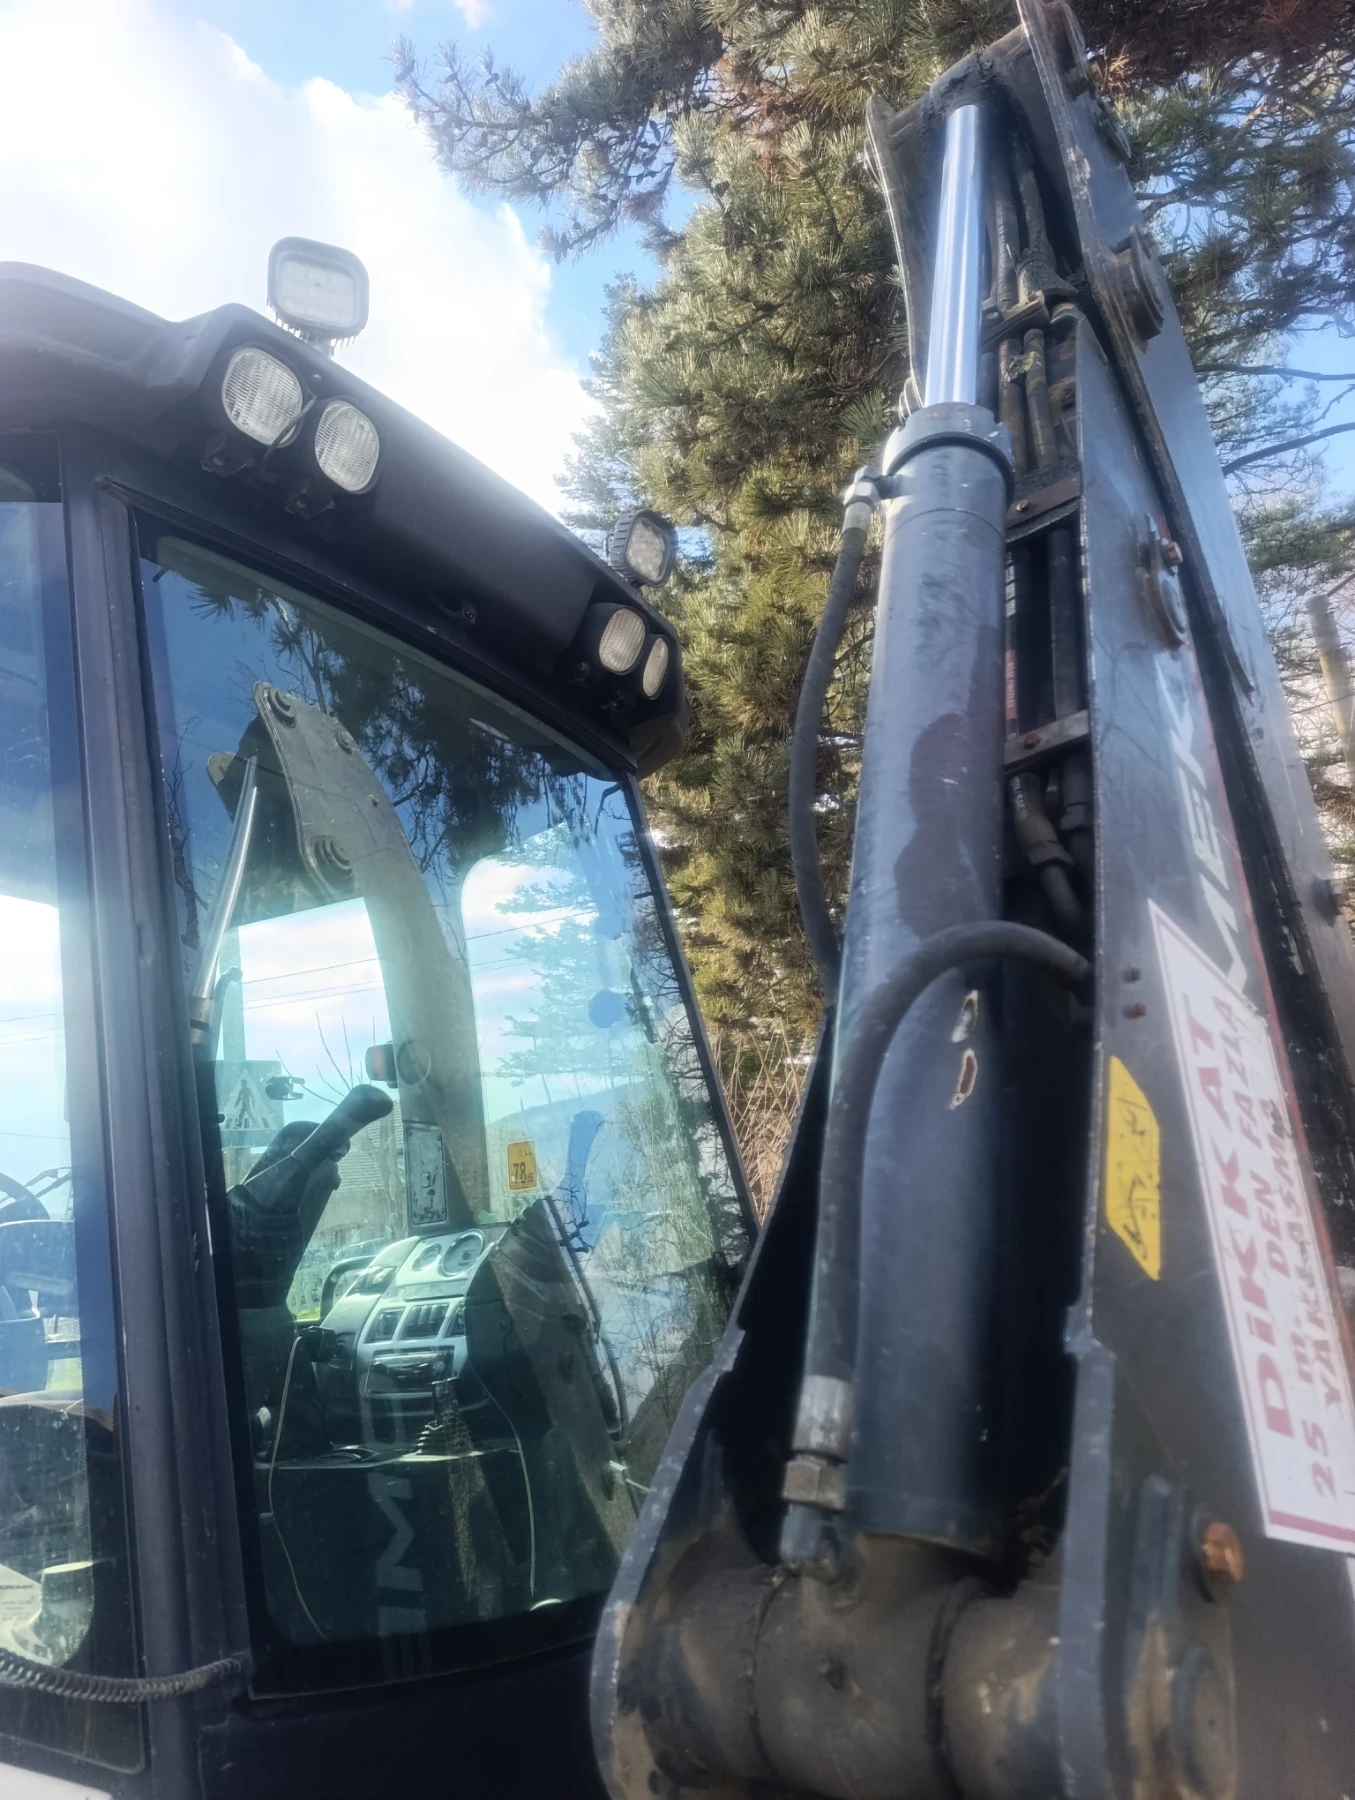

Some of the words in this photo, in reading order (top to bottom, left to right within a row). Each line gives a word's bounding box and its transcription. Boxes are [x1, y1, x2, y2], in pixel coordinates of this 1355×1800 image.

[1212, 996, 1262, 1149] FAZLA
[513, 1162, 526, 1184] 78
[1250, 1167, 1291, 1279] DEN
[1302, 1418, 1337, 1501] 25
